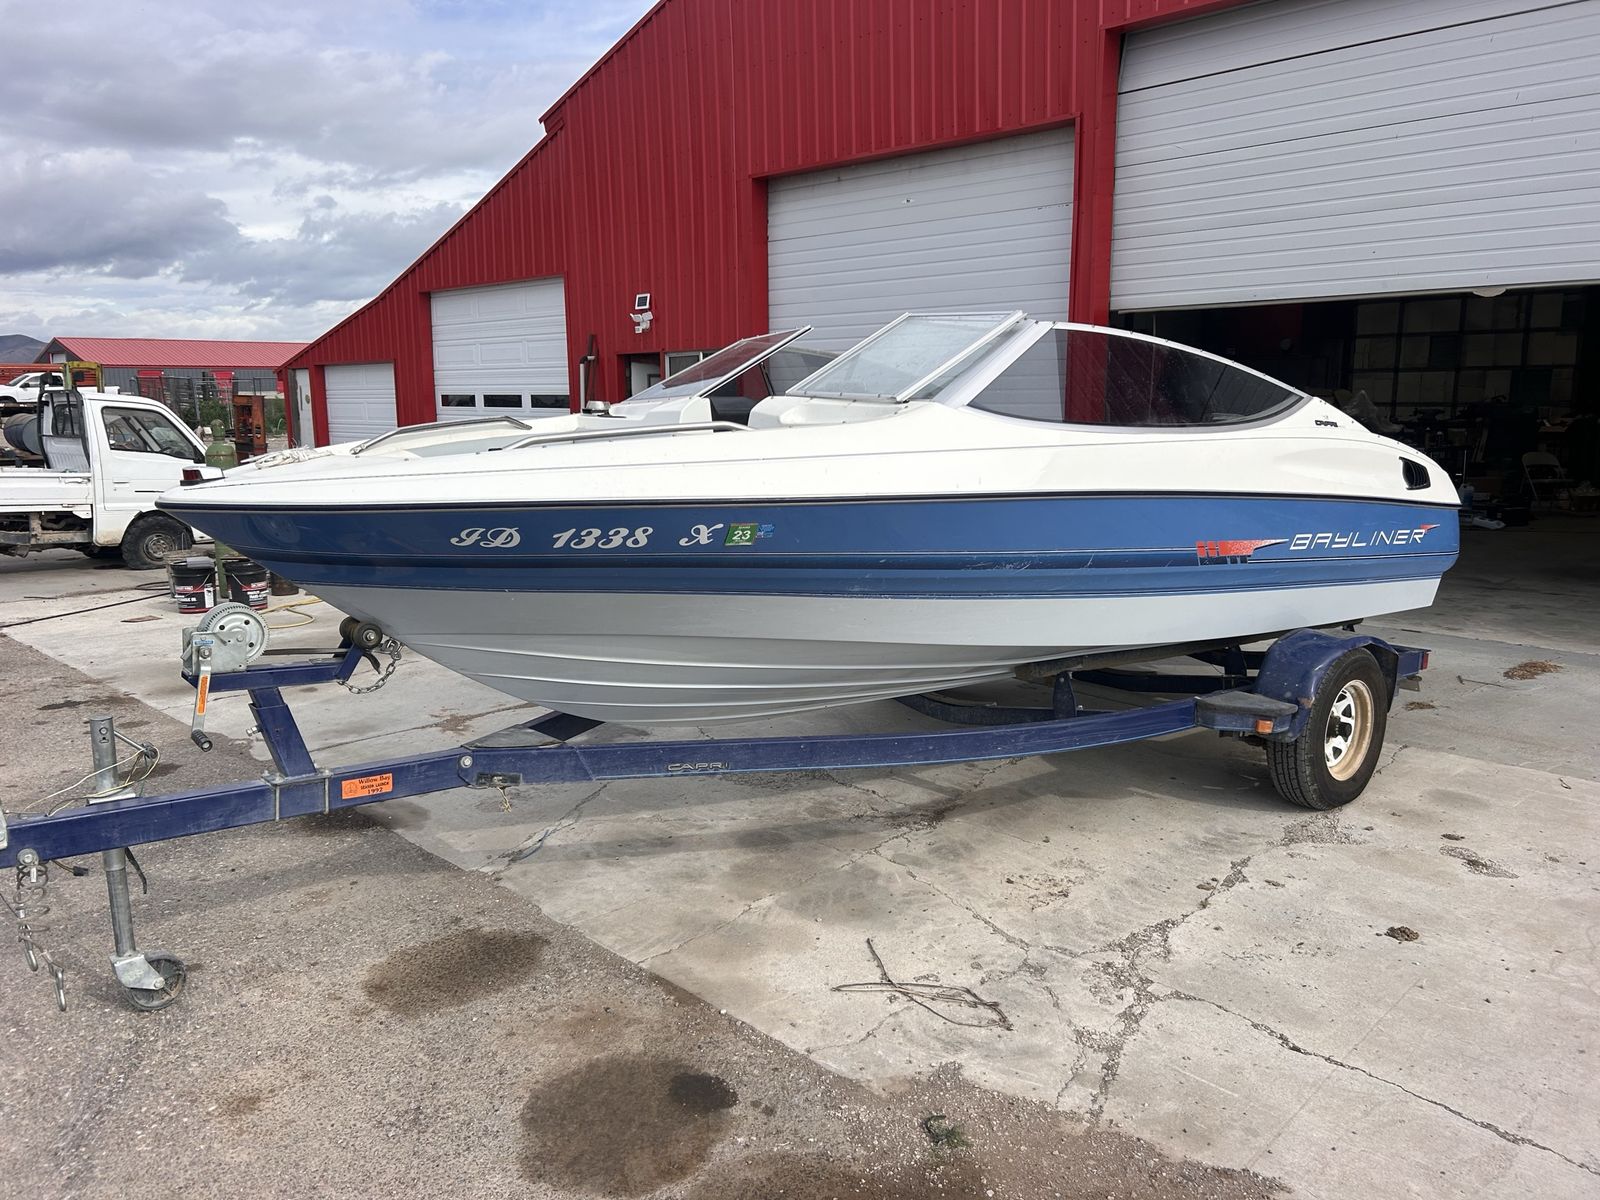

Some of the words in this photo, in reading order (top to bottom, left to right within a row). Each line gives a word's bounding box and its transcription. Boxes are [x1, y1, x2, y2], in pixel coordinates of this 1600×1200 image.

[450, 527, 521, 548] ID
[552, 526, 654, 549] 1338
[679, 523, 724, 547] X
[732, 530, 751, 540] 23
[1289, 529, 1426, 550] BAYLINER
[667, 762, 729, 771] CAPRI
